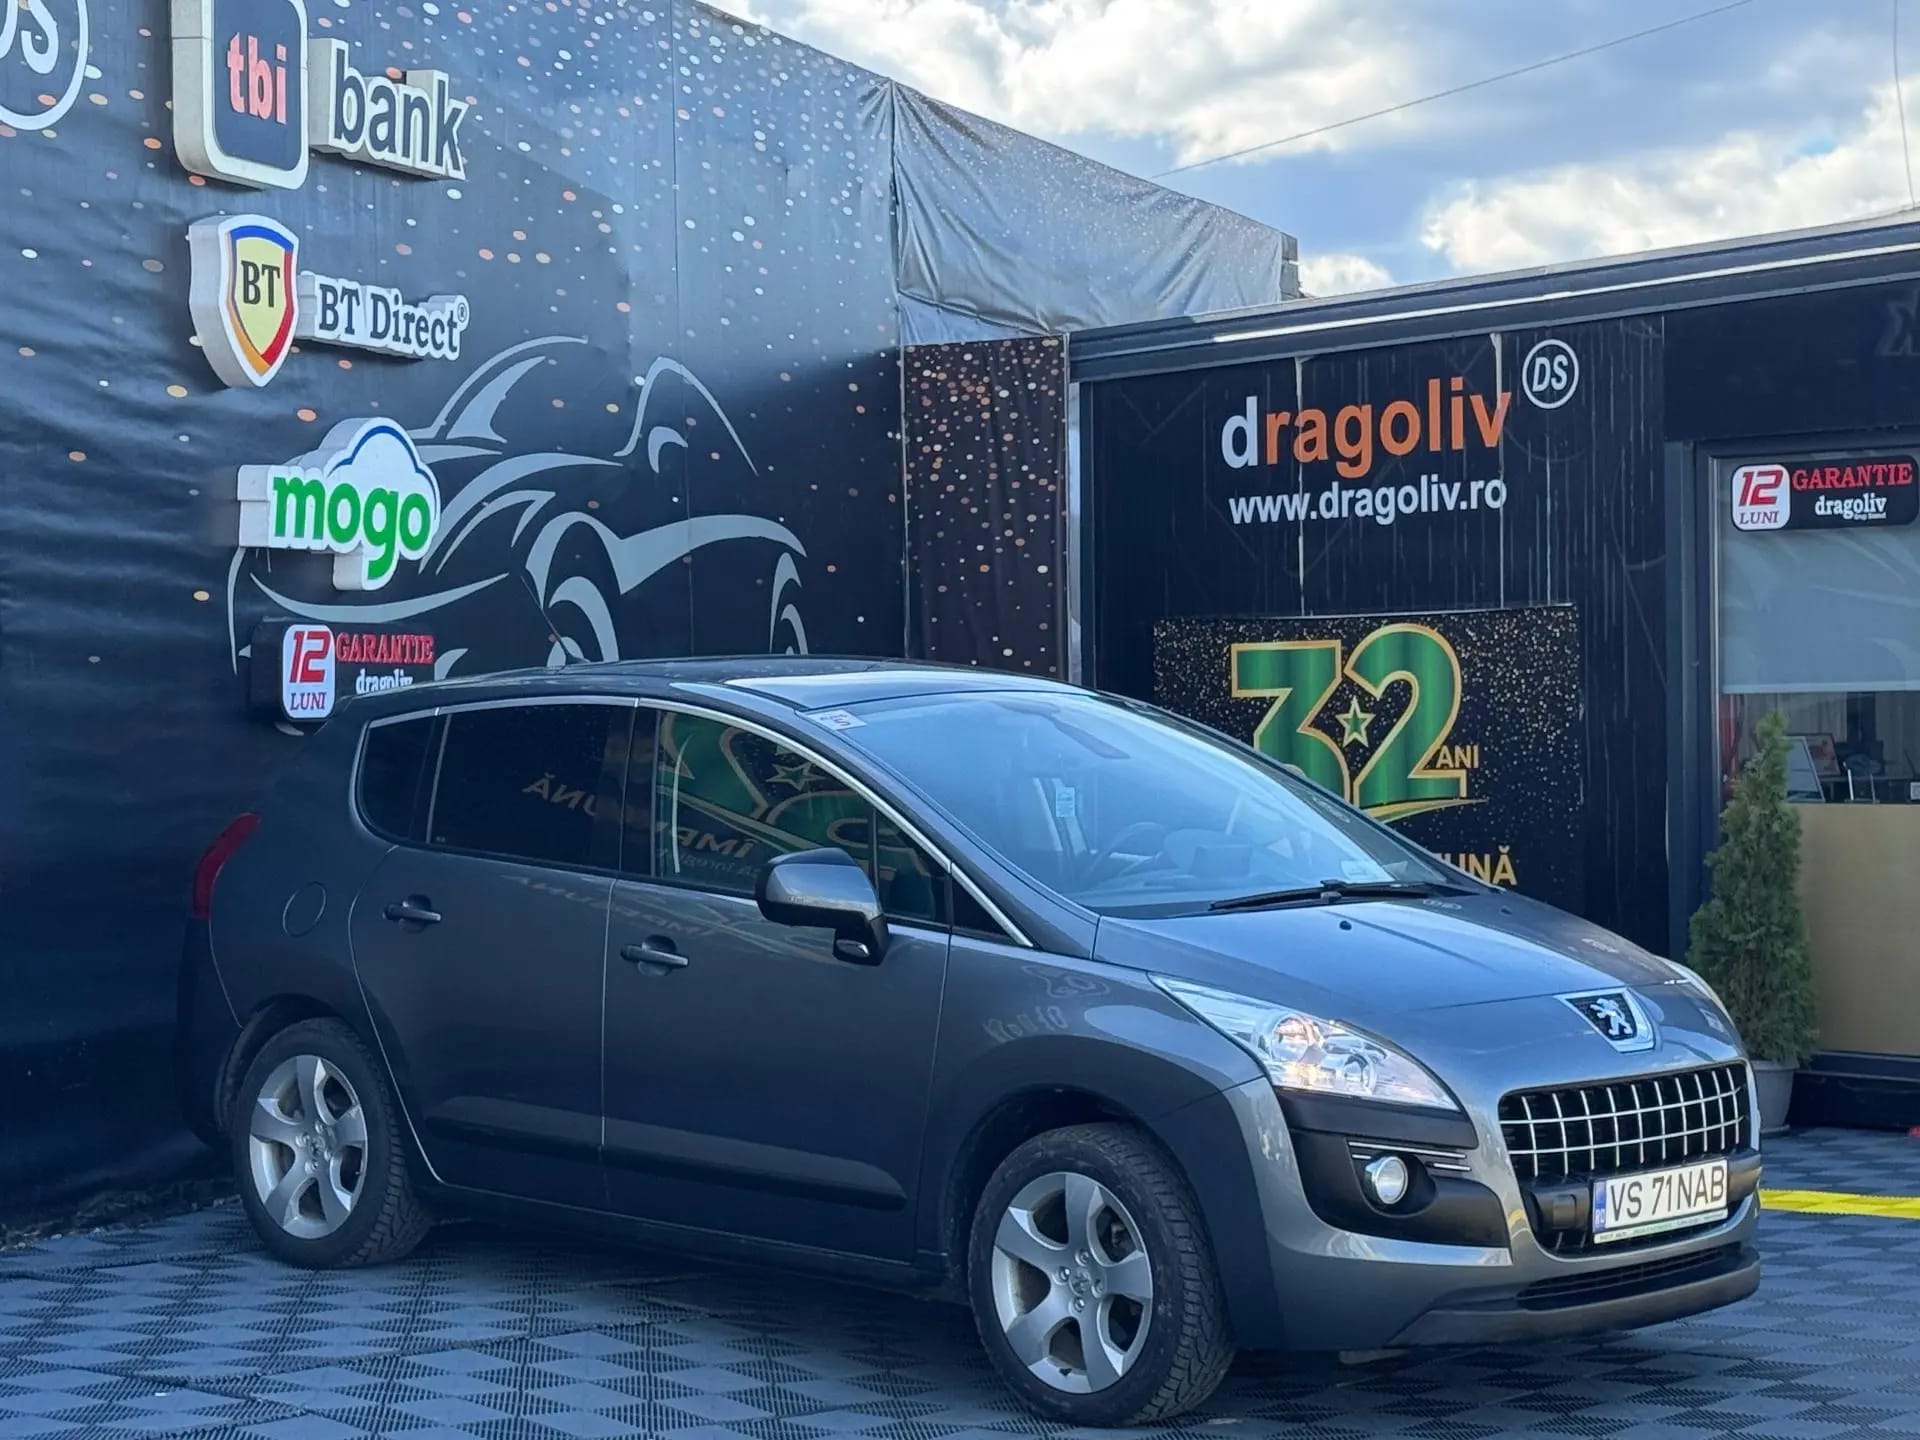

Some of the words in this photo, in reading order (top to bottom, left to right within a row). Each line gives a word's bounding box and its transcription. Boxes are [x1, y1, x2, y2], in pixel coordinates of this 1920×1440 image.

[0, 0, 59, 74] S
[226, 31, 288, 125] tbi
[335, 47, 463, 172] bank
[240, 260, 281, 308] BT
[319, 283, 360, 336] BT
[1532, 354, 1569, 392] DS
[1221, 376, 1512, 478] dragoliv
[1228, 474, 1508, 525] www.dragoliv.ro
[1738, 469, 1784, 507] 12
[1791, 462, 1913, 491] GARANTIE
[273, 475, 432, 580] mogo
[1738, 511, 1779, 525] LUNI
[1814, 492, 1888, 520] dragoliv
[288, 630, 332, 683] 12
[335, 631, 434, 664] GARANTIE
[289, 691, 327, 711] LUNI
[1231, 622, 1467, 805] 32
[1435, 744, 1480, 769] ANI
[1610, 1181, 1643, 1222] VS
[1652, 1165, 1725, 1216] 71NAB
